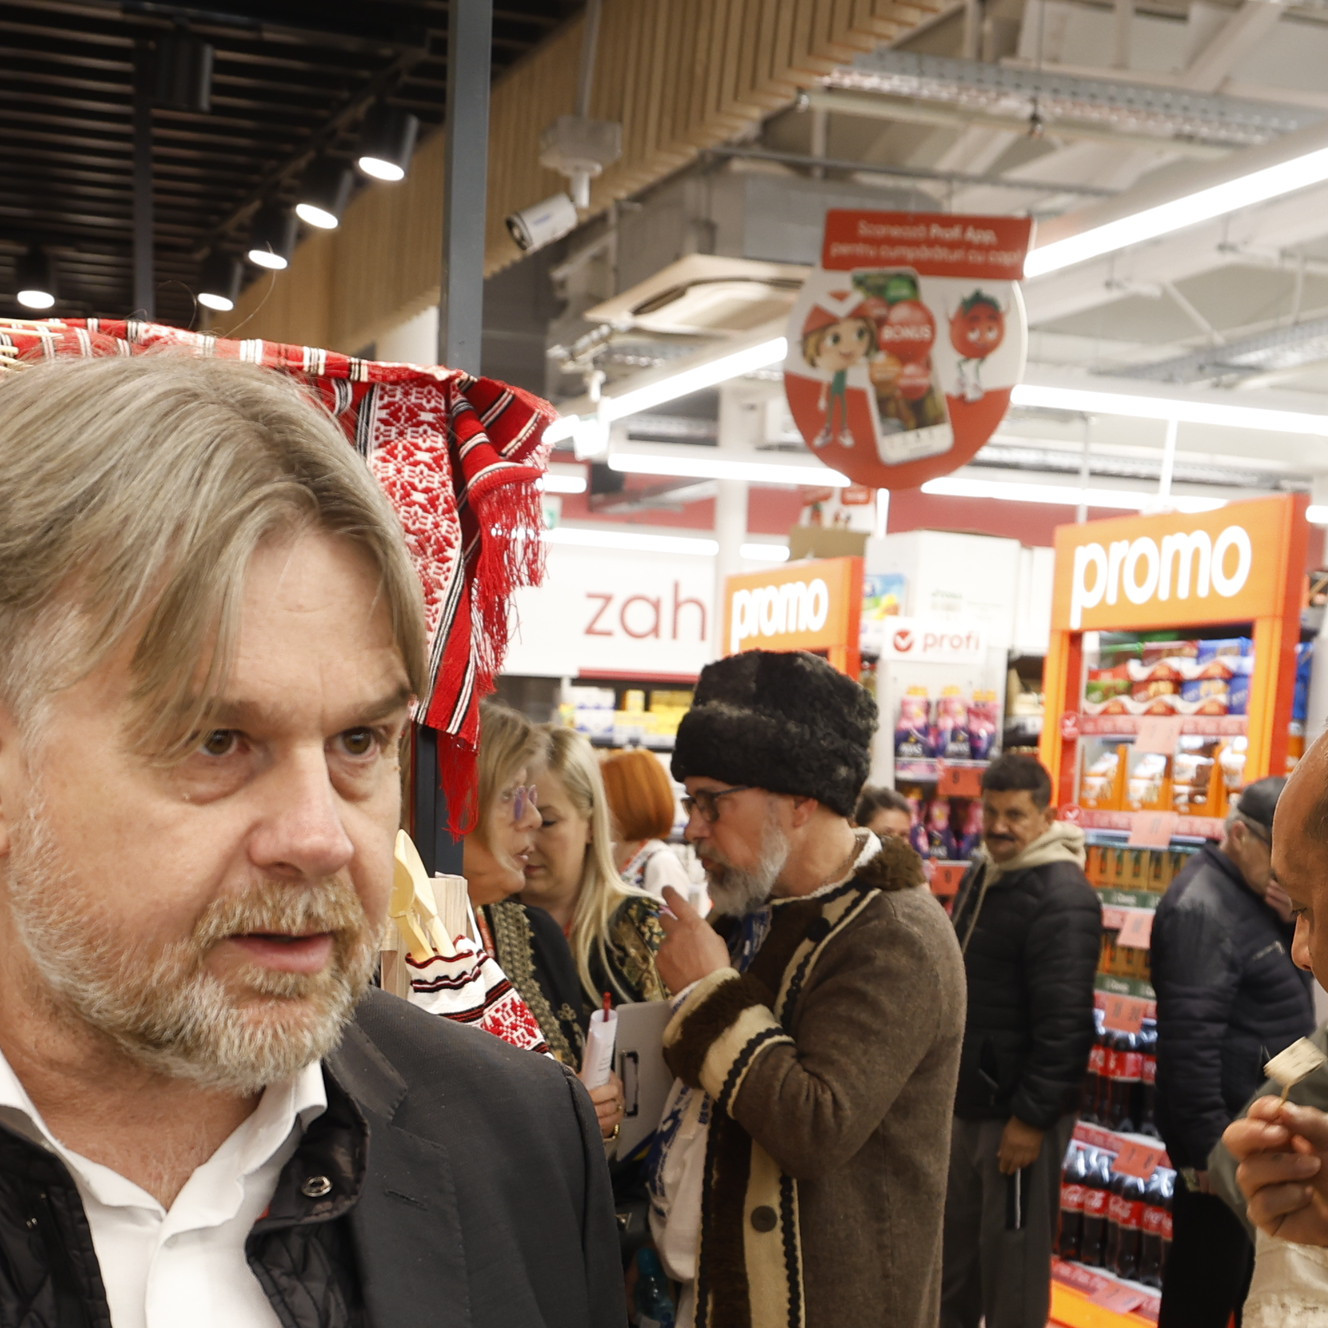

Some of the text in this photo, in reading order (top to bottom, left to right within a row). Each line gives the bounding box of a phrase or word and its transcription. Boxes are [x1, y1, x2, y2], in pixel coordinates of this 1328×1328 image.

[881, 324, 932, 341] BONUS
[1070, 525, 1252, 630] promo
[584, 580, 707, 641] zah
[730, 578, 830, 654] promo
[923, 631, 981, 651] profi
